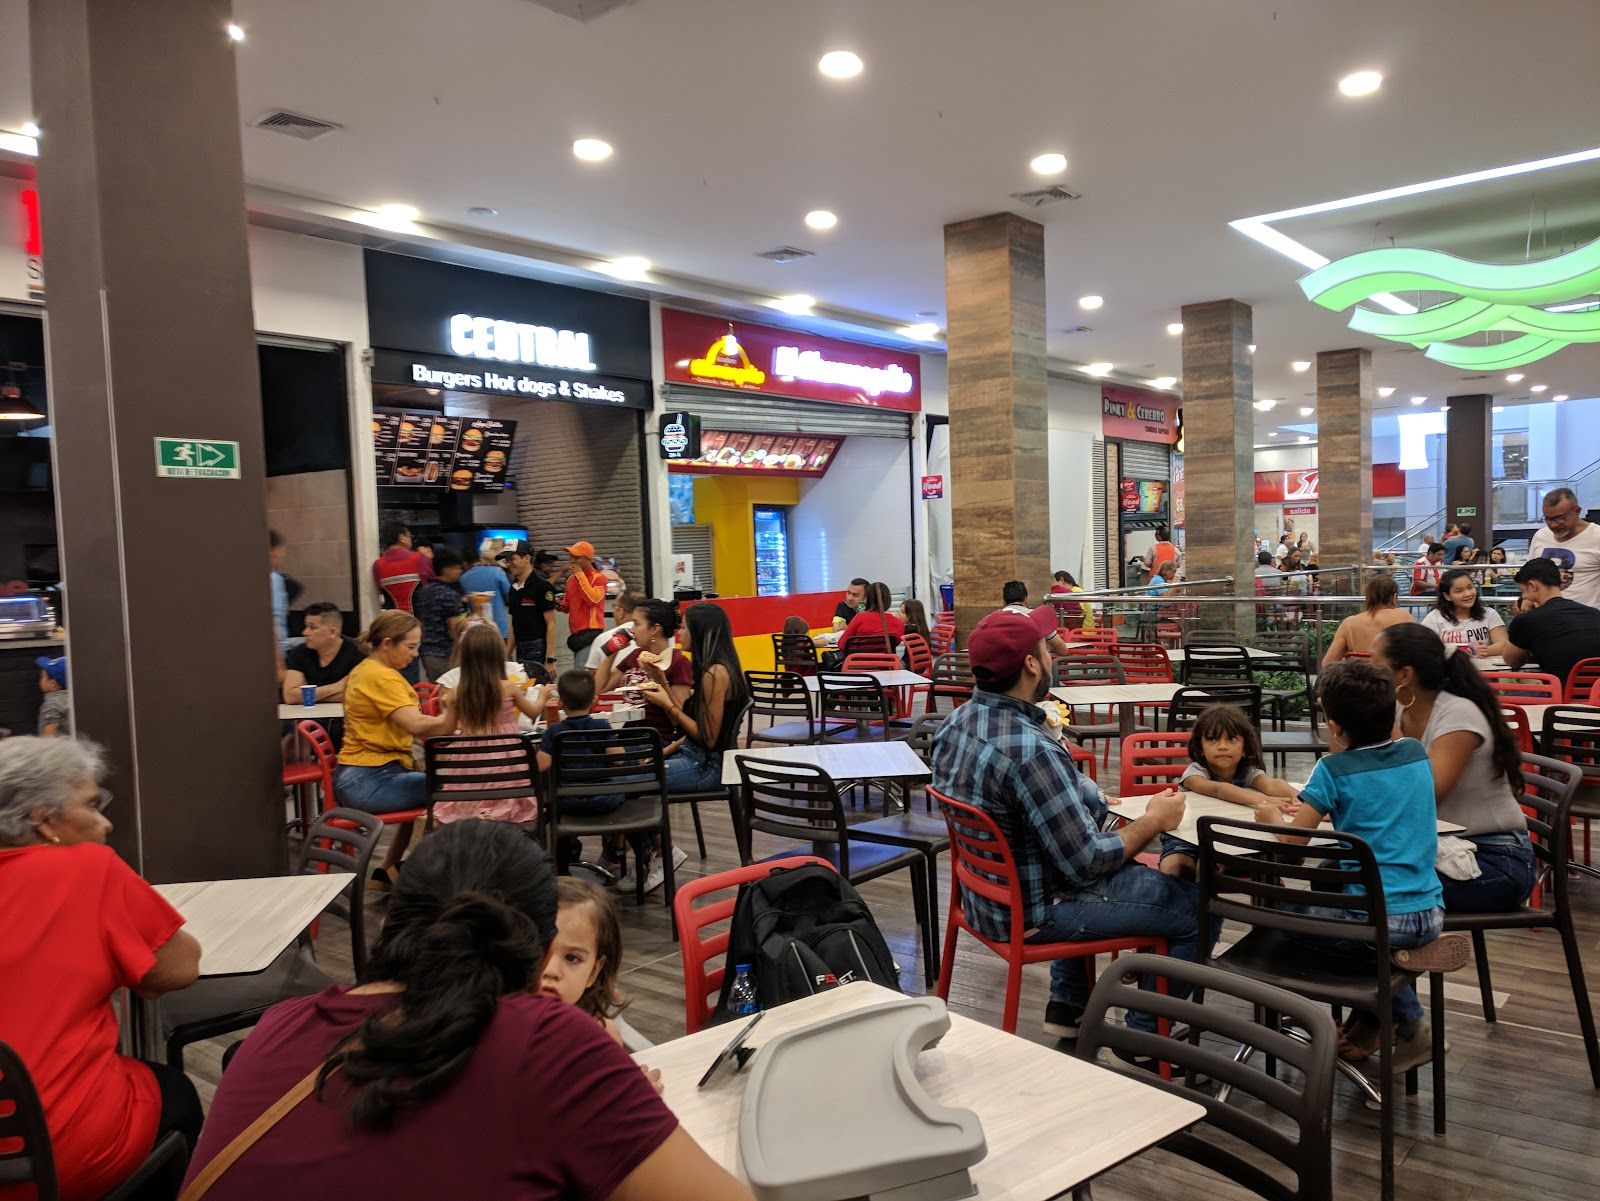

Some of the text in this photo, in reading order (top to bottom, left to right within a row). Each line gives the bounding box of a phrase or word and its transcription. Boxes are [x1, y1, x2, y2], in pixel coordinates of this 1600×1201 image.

[450, 314, 597, 371] CENTRAL
[412, 363, 625, 403] Burgers Hot dogs & Shakes
[1128, 402, 1136, 419] &
[1290, 507, 1310, 515] salida
